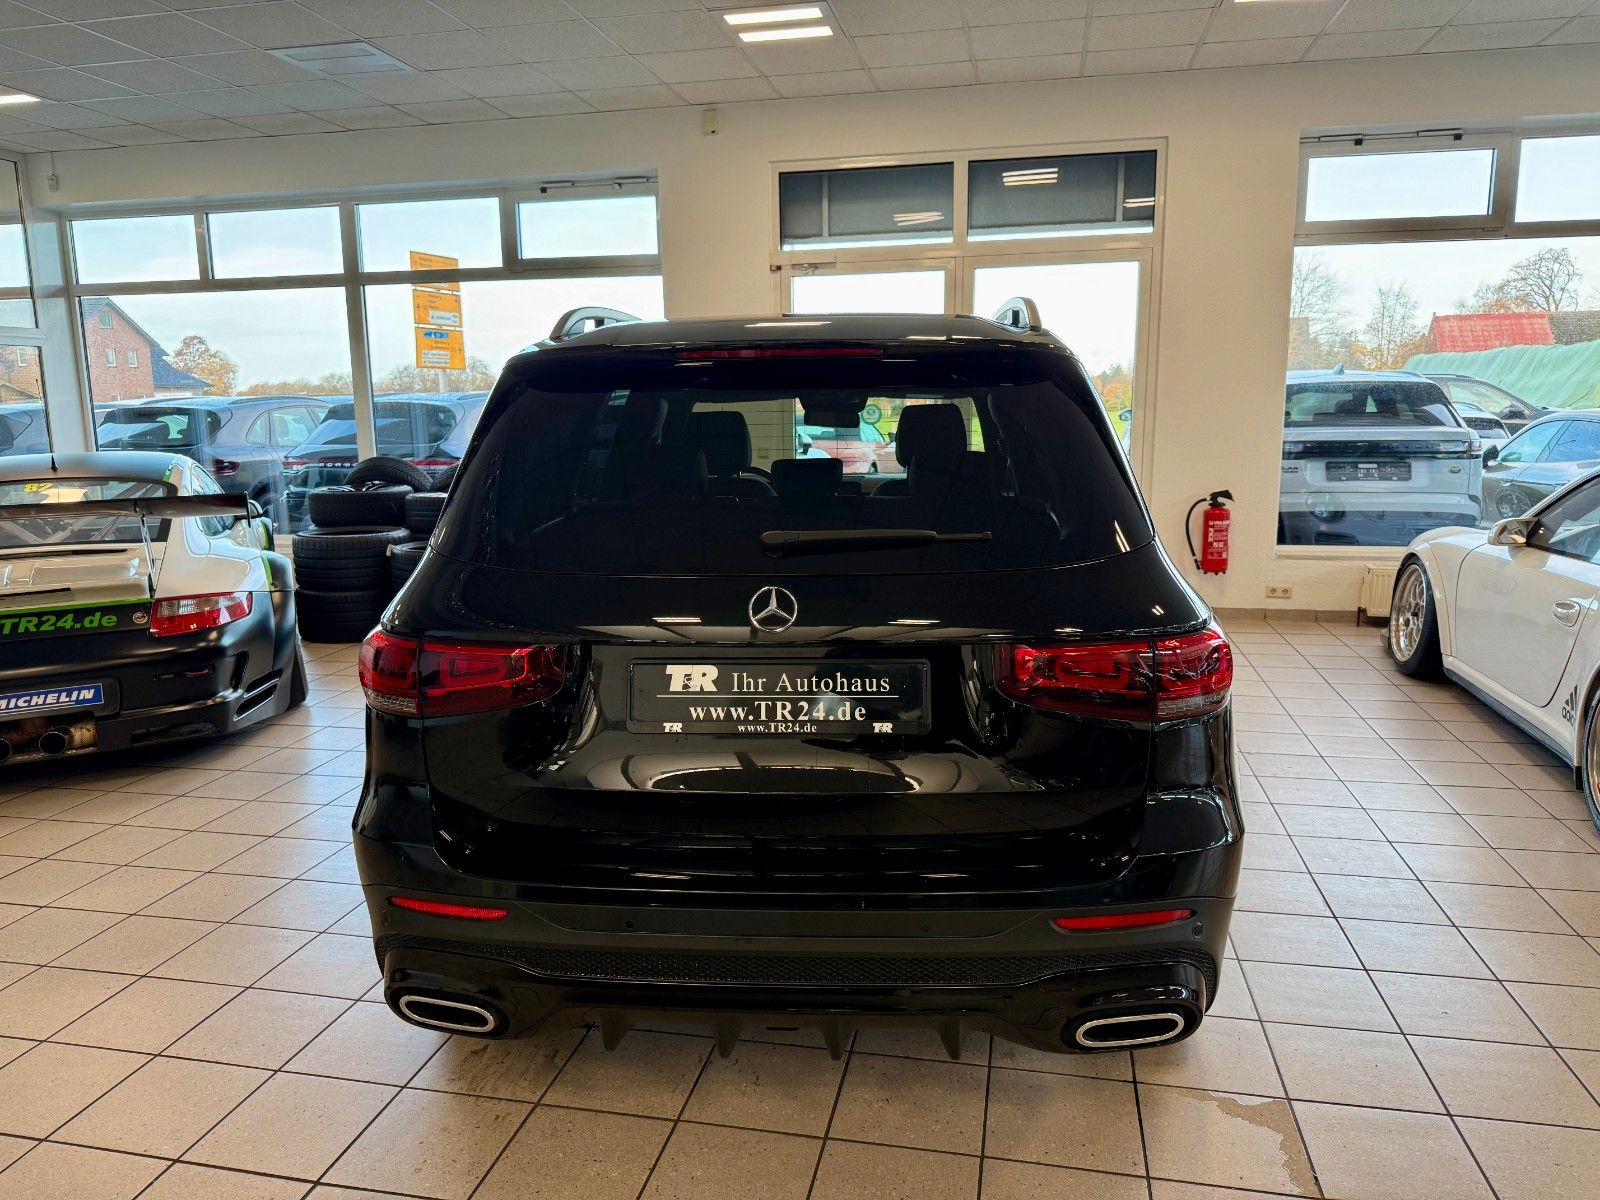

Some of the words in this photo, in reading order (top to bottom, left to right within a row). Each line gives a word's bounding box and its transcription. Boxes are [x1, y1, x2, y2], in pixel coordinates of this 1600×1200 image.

[0, 612, 117, 634] TR24.de
[732, 672, 766, 692] Ihr
[775, 672, 890, 692] Autohaus
[689, 701, 866, 720] www.TR24.de
[738, 722, 817, 733] www.TR24.de
